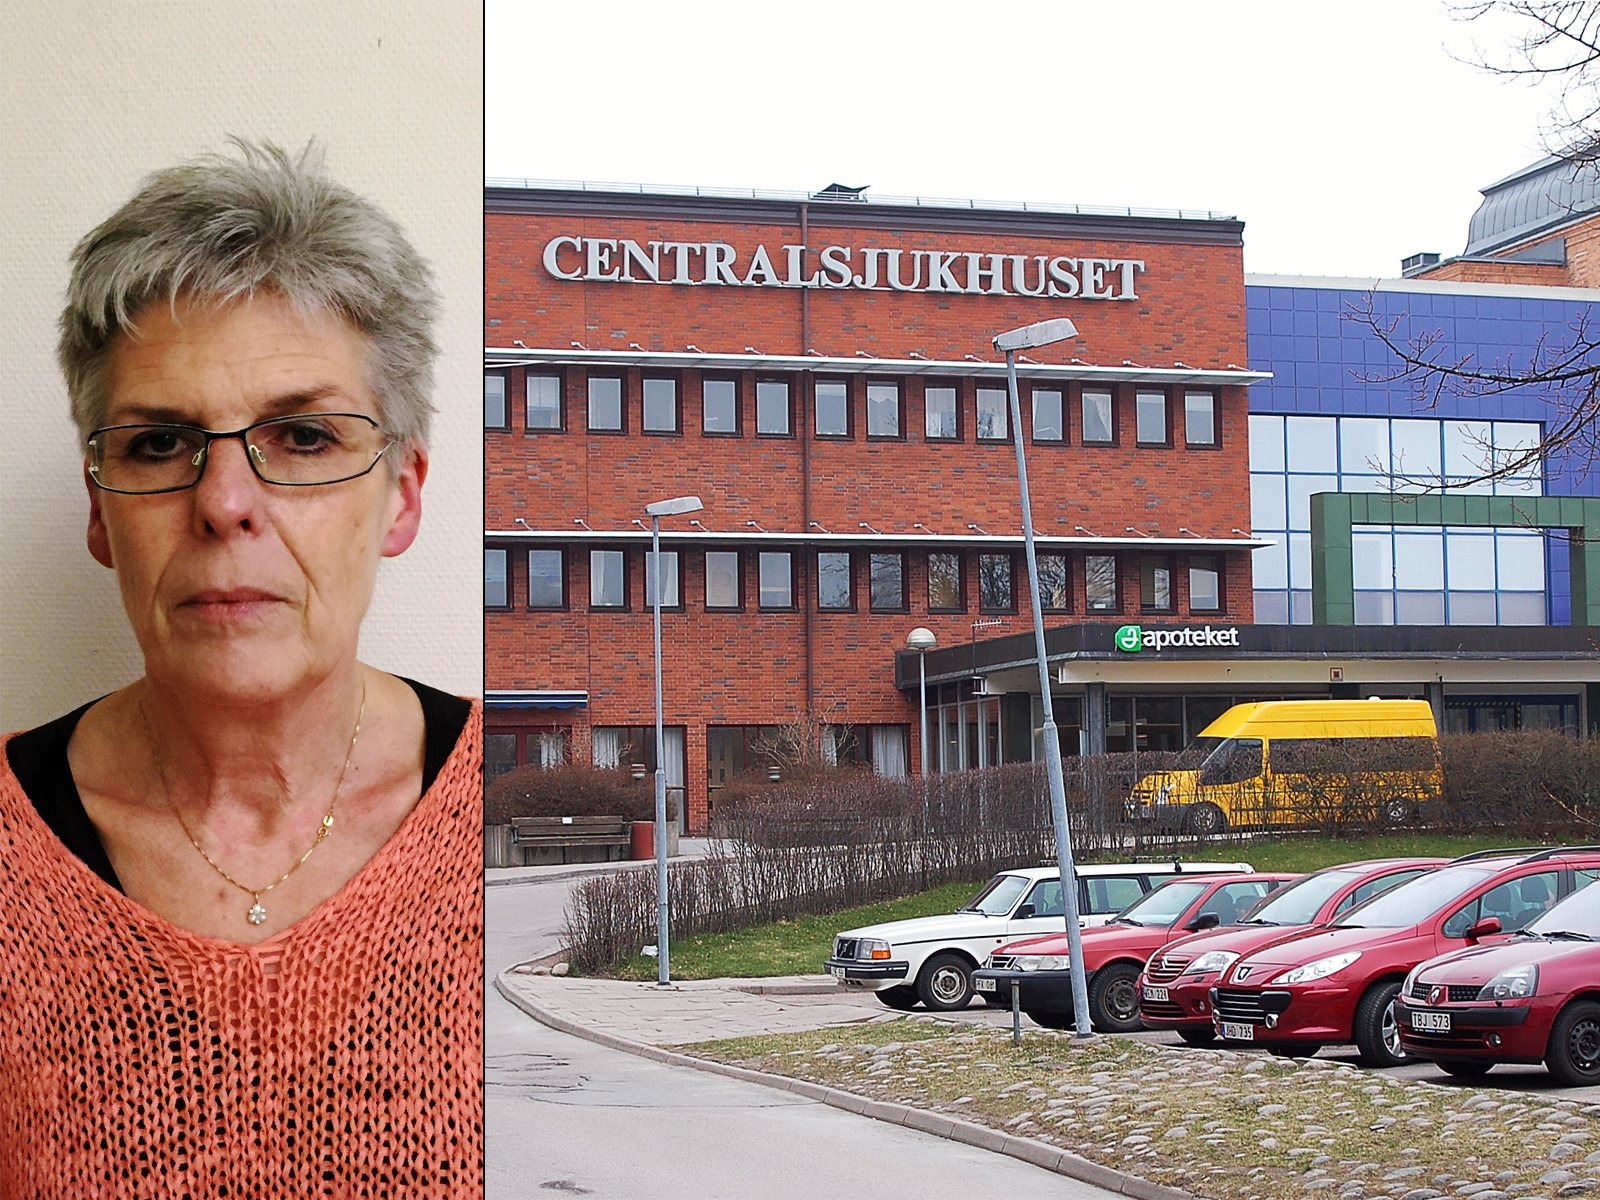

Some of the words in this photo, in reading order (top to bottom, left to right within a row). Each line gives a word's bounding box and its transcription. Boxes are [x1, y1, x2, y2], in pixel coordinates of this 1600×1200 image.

[542, 235, 1145, 300] CENTRALSJUKHUSET
[1142, 625, 1240, 651] apoteket
[1412, 1013, 1428, 1027] TBJ
[1432, 1014, 1449, 1028] 573
[1239, 1025, 1252, 1038] 735
